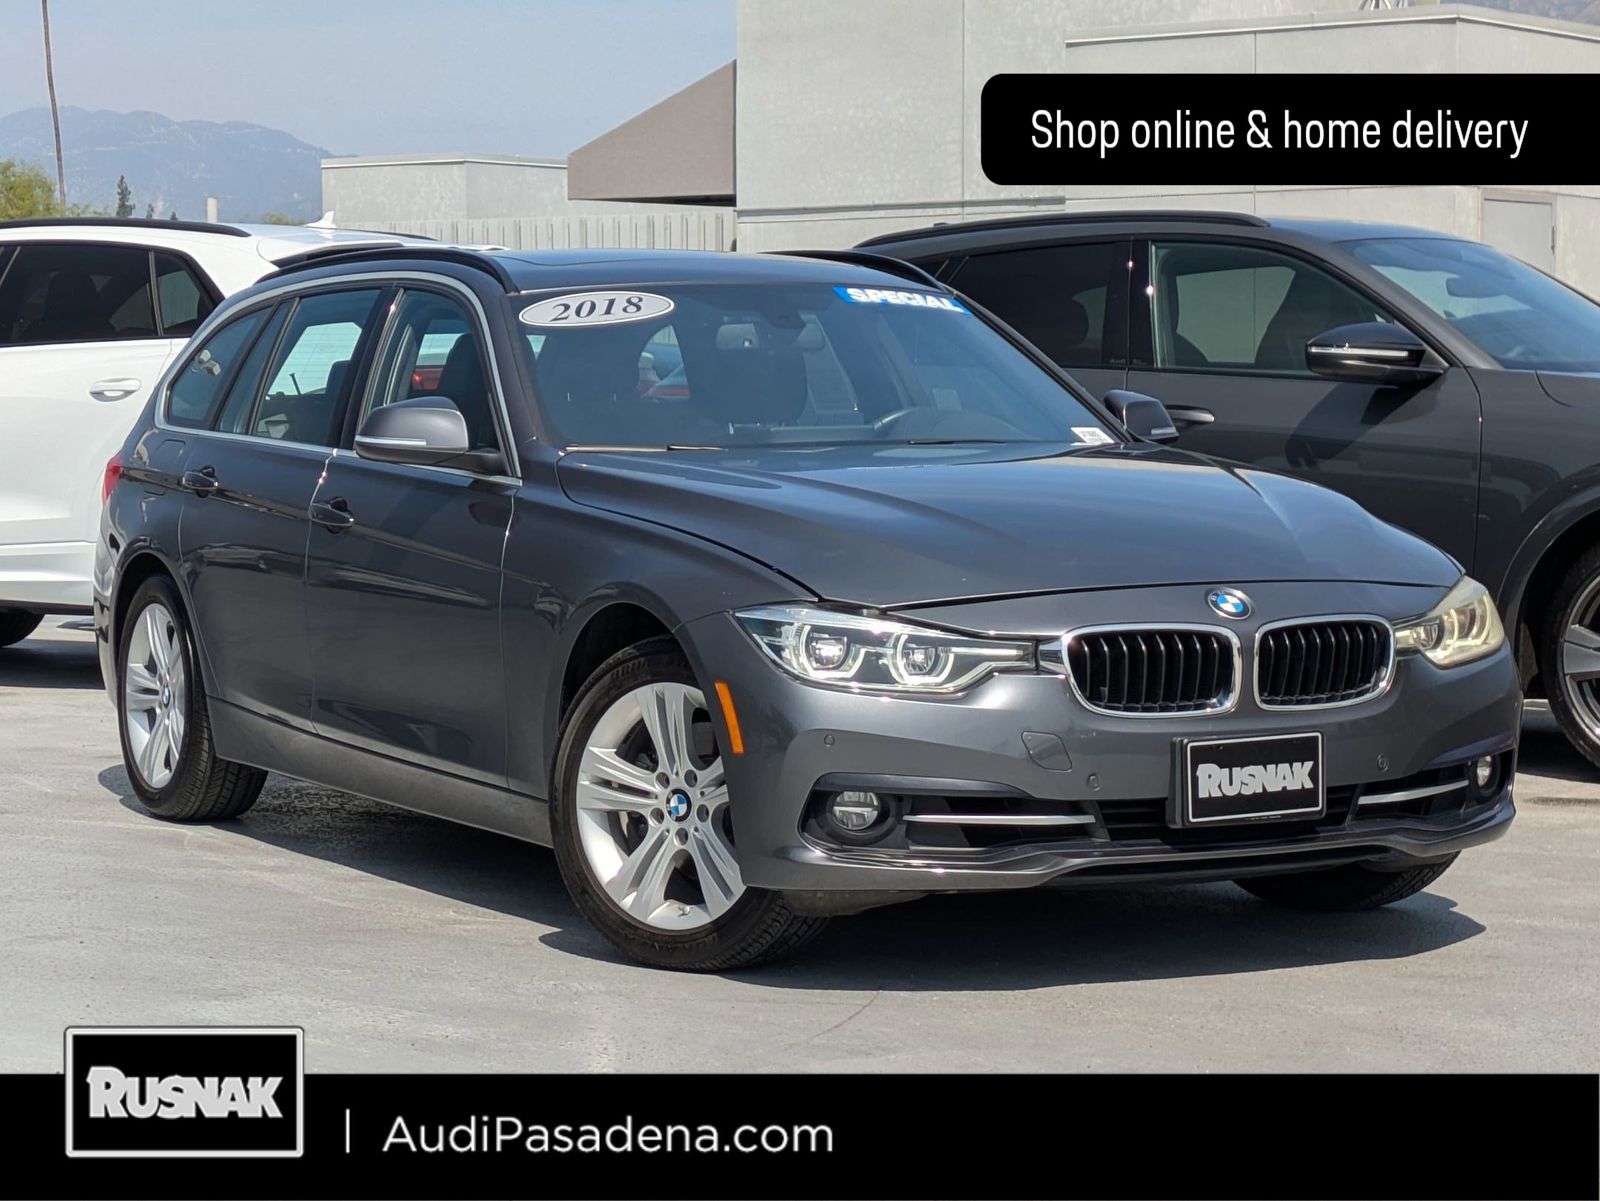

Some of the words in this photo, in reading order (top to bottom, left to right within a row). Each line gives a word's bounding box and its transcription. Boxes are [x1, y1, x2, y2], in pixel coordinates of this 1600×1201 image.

[550, 295, 644, 322] 2018
[846, 287, 966, 313] SPECIAL
[1196, 760, 1314, 799] RUSNAK
